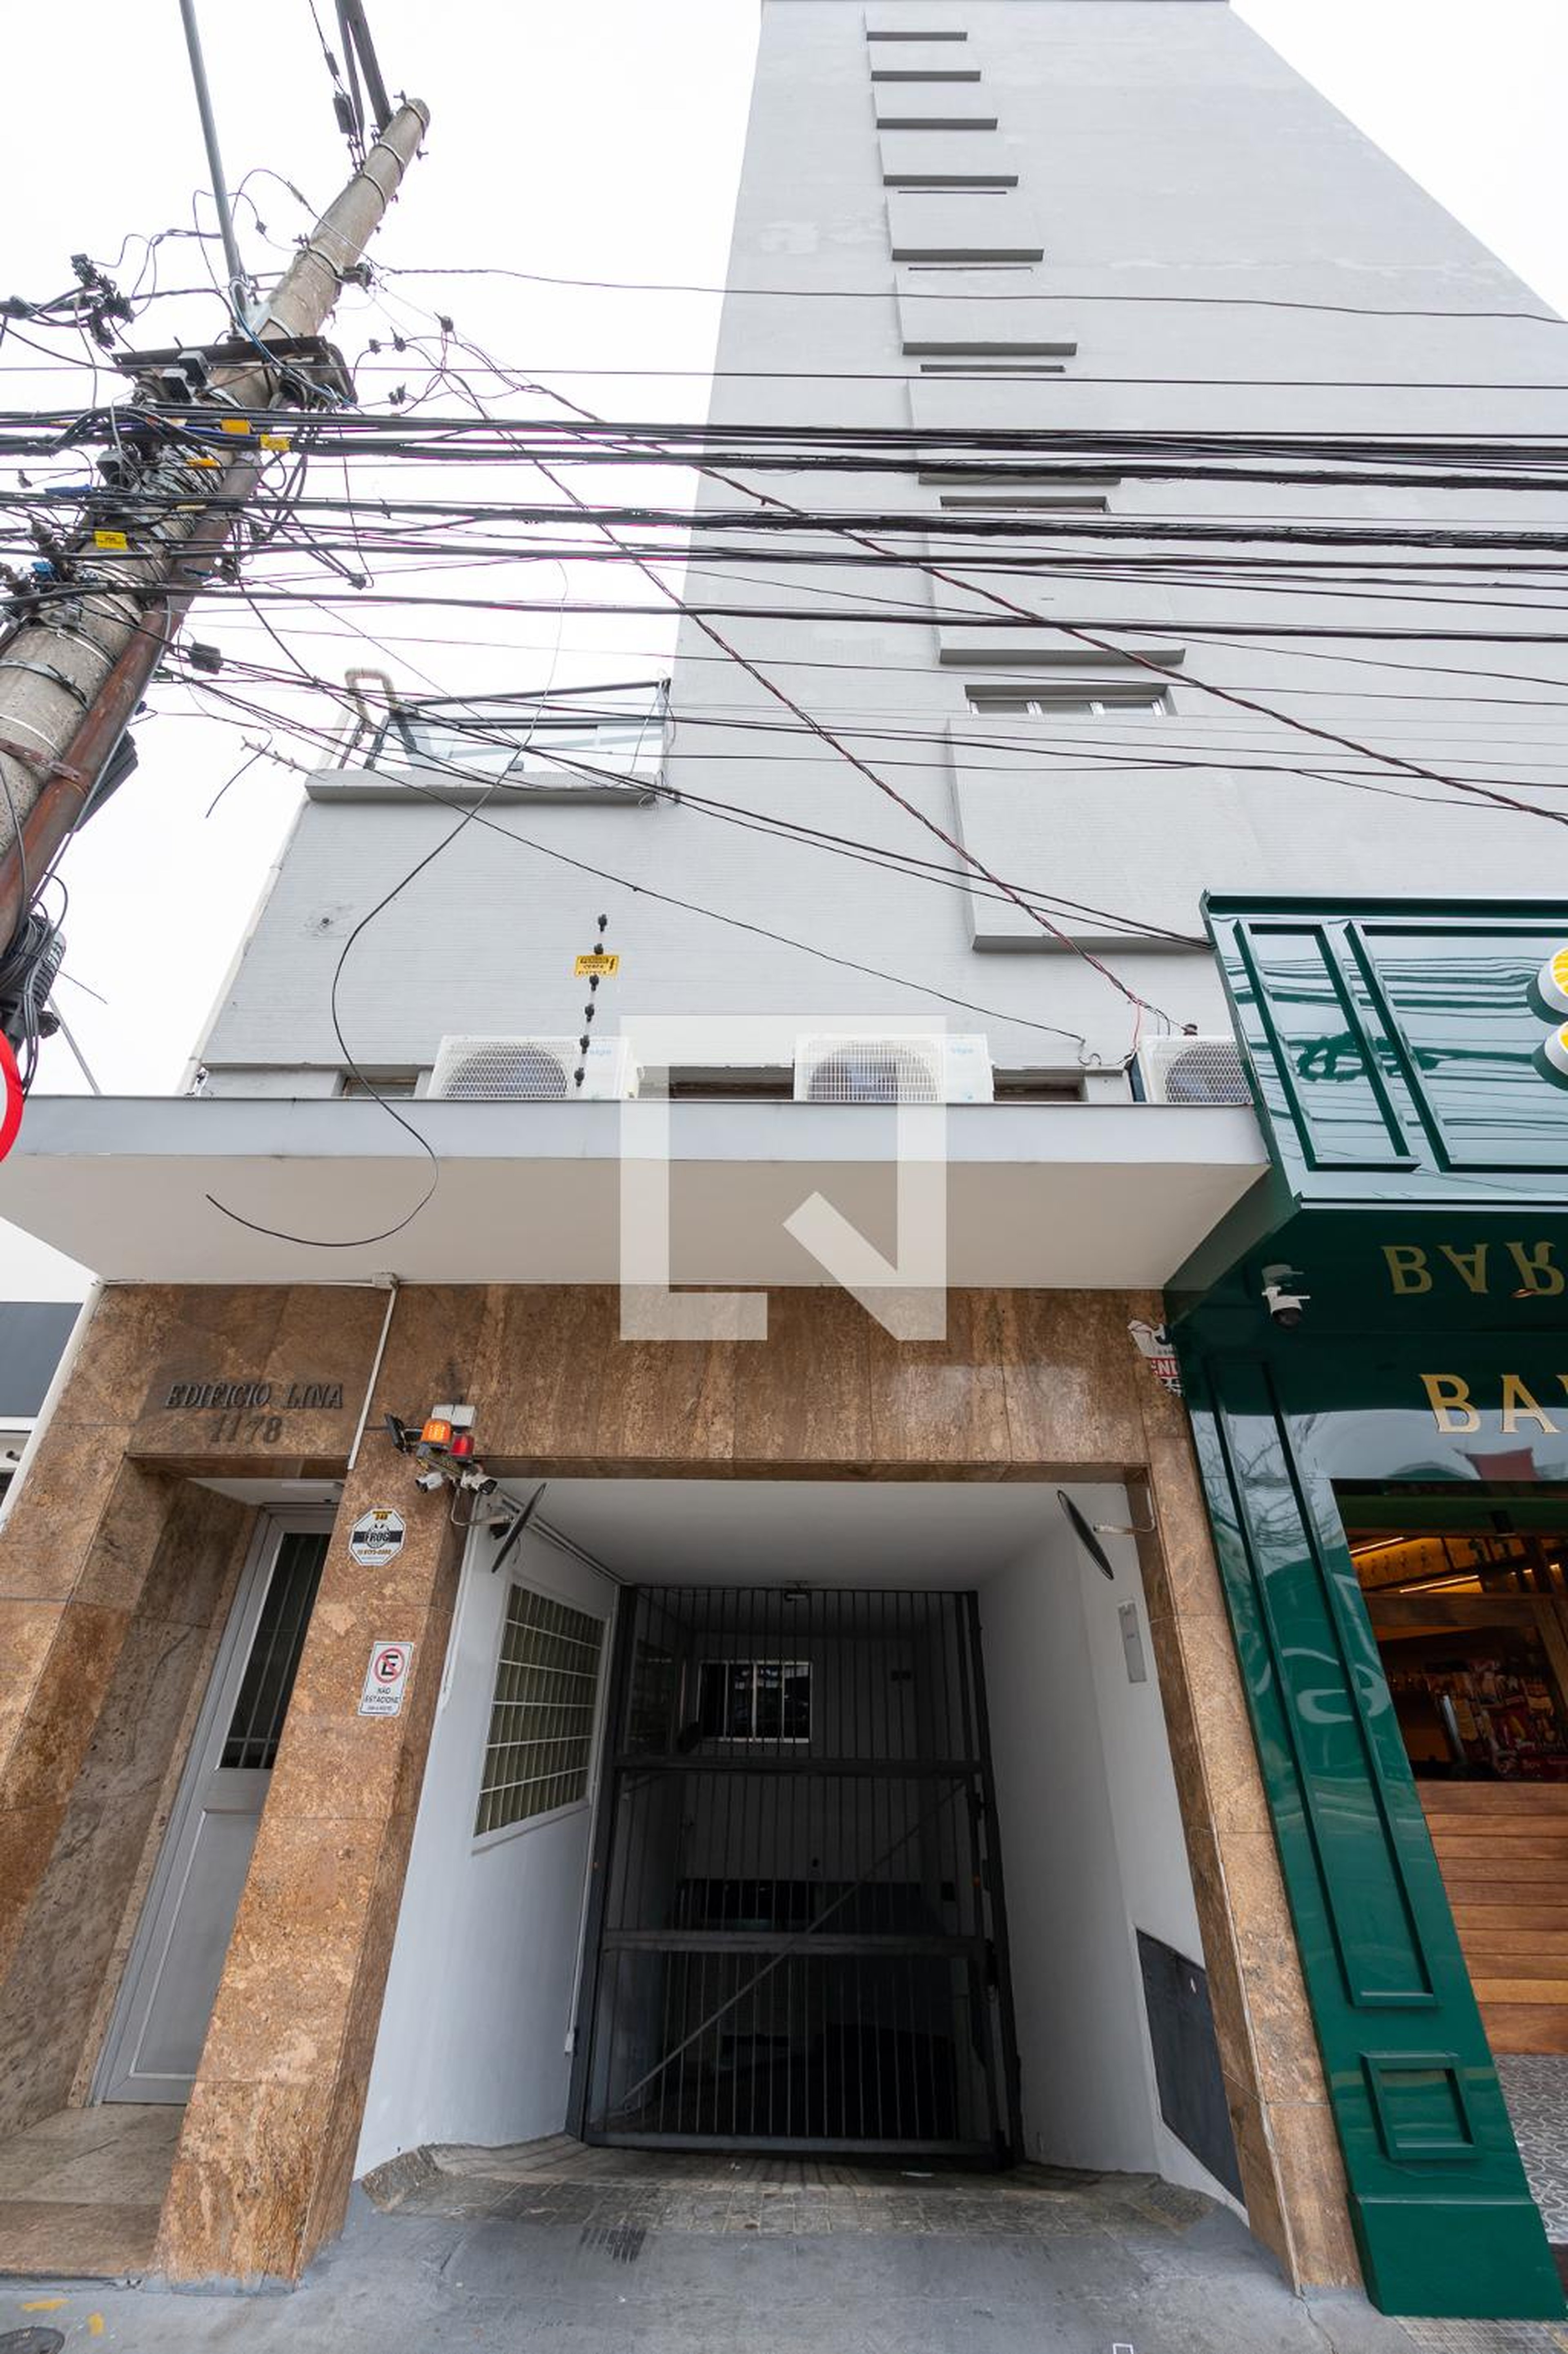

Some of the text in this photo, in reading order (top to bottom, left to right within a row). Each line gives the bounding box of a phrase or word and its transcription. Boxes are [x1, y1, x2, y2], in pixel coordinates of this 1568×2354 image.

[283, 1383, 343, 1409] LINA
[1419, 1373, 1568, 1433] BA
[209, 1412, 283, 1444] 1178
